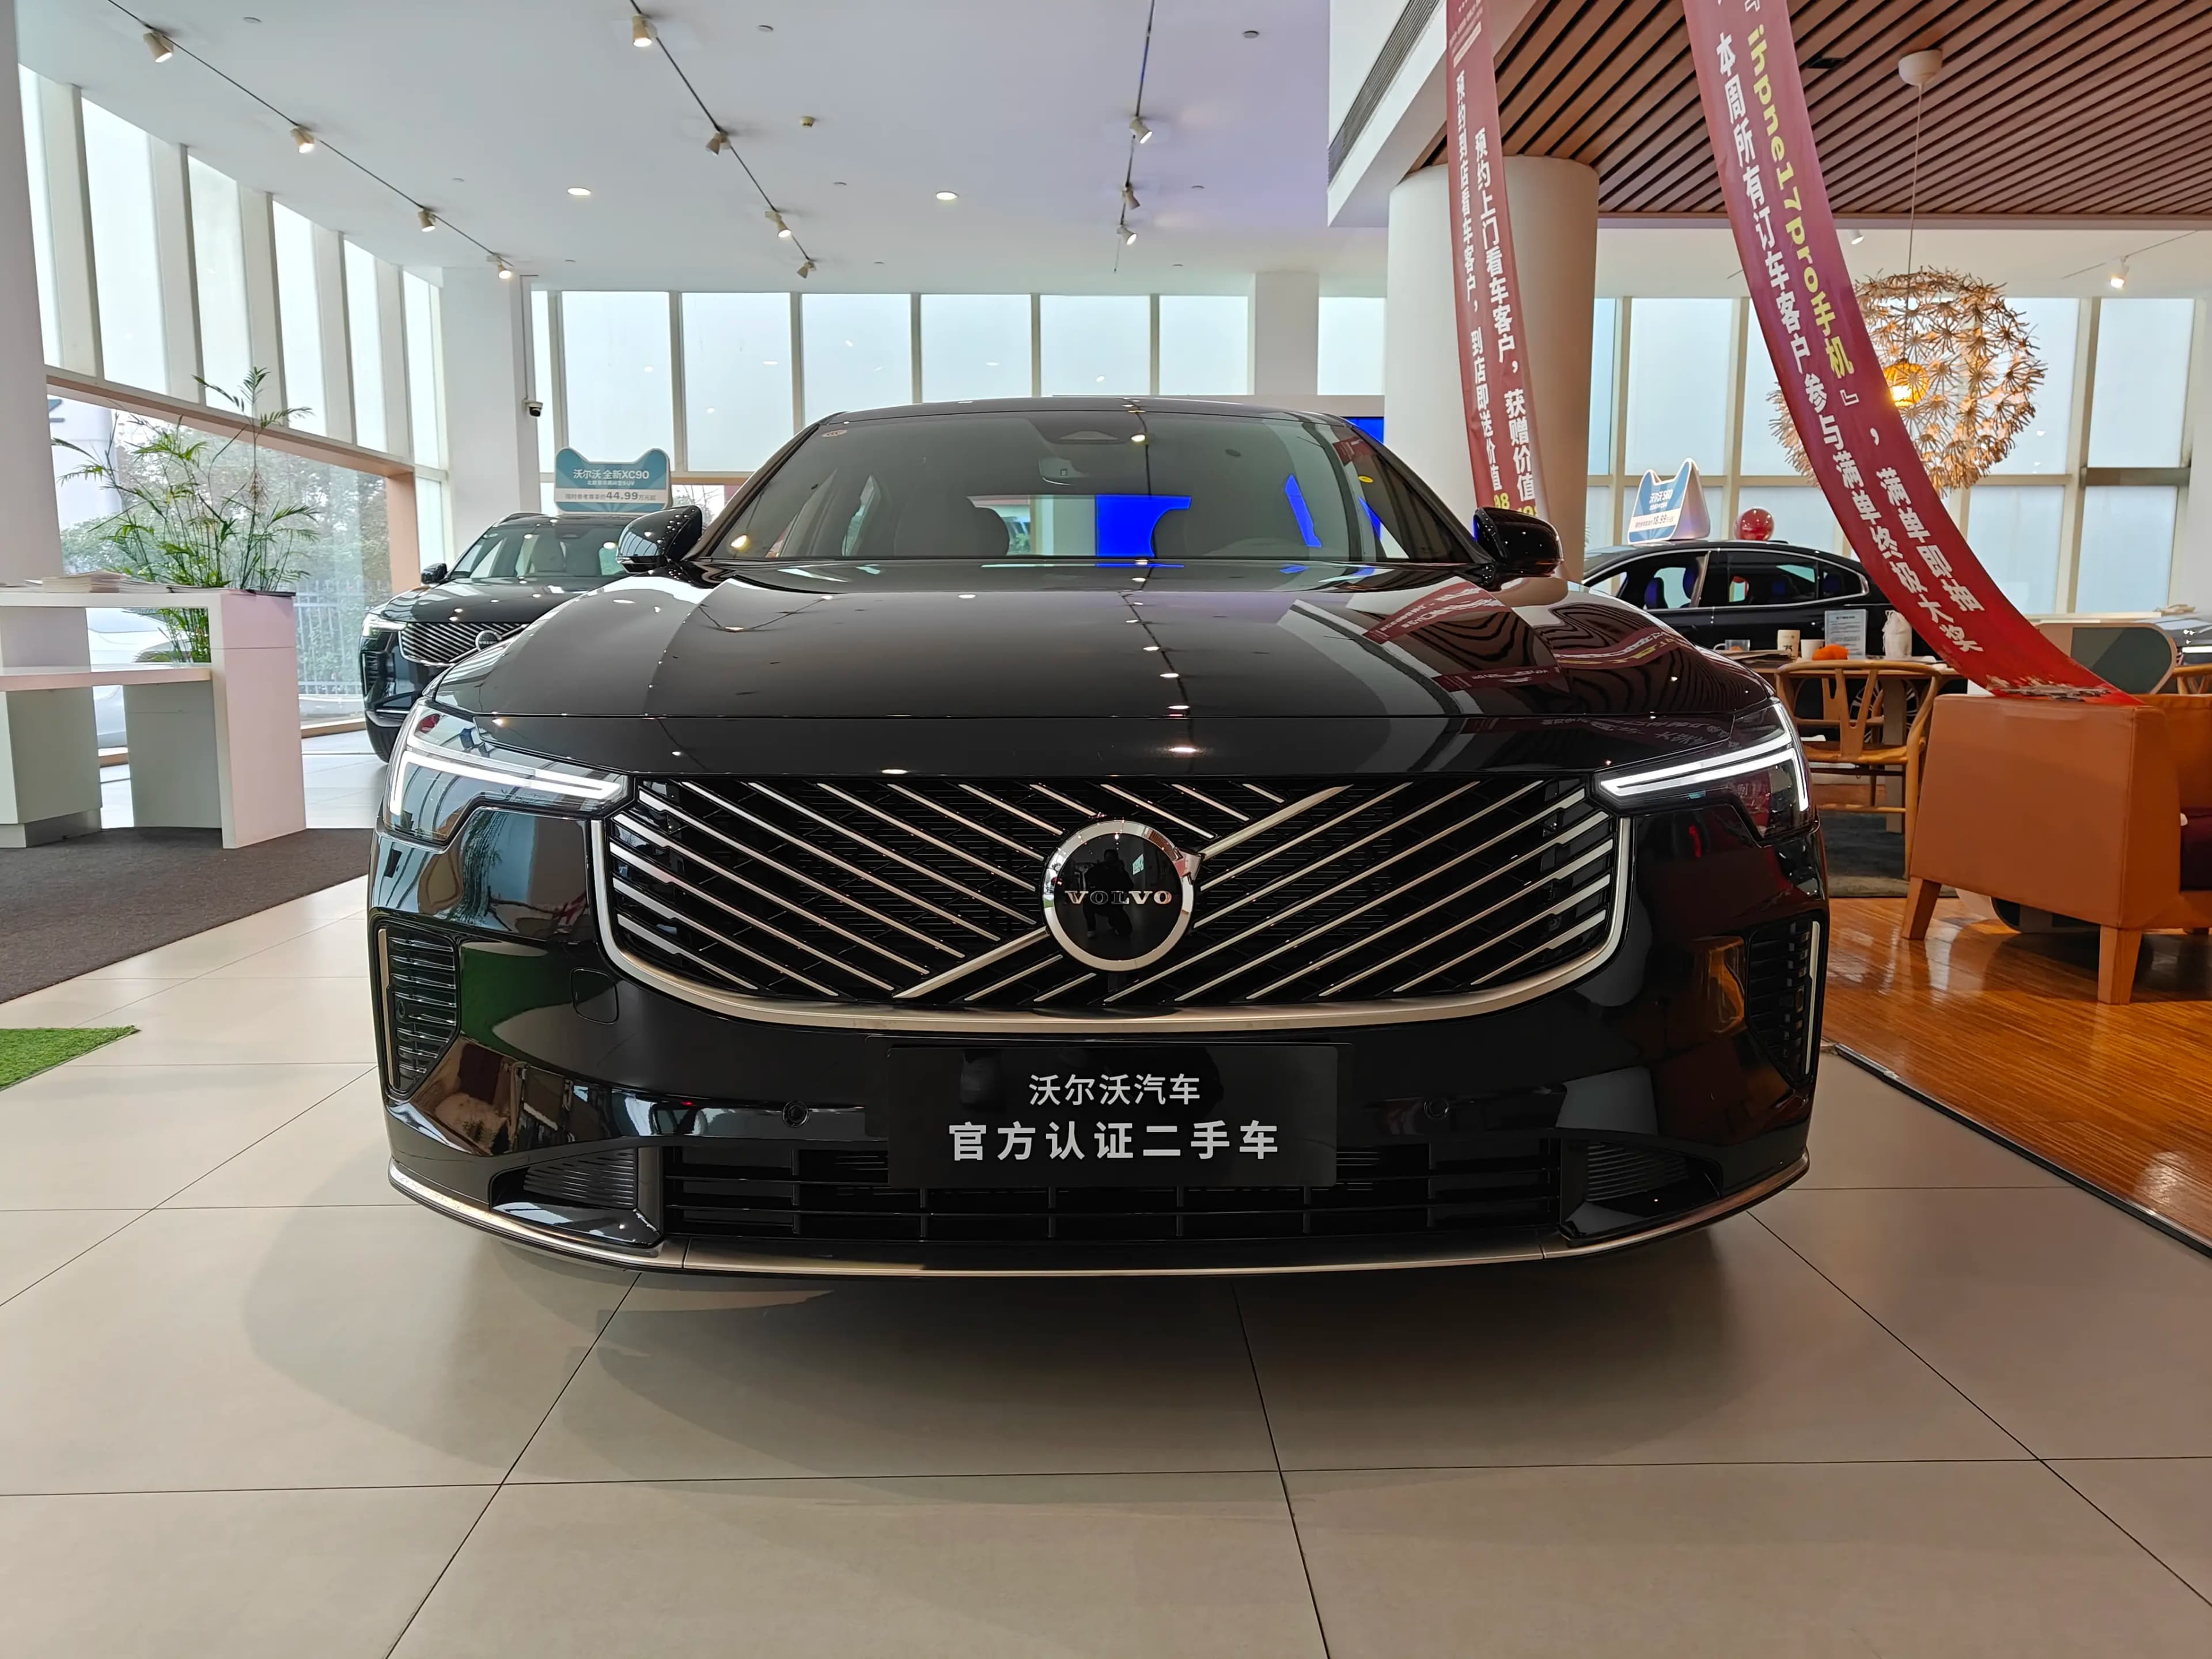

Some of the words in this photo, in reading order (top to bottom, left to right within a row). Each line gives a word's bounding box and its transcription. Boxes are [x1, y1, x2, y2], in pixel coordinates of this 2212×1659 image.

[573, 469, 601, 479] 沃尔沃
[603, 469, 650, 479] 全新XC90
[1065, 890, 1172, 905] VOLVO
[1028, 1073, 1201, 1106] 沃尔沃汽车
[948, 1119, 1279, 1161] 官方认证二手车
